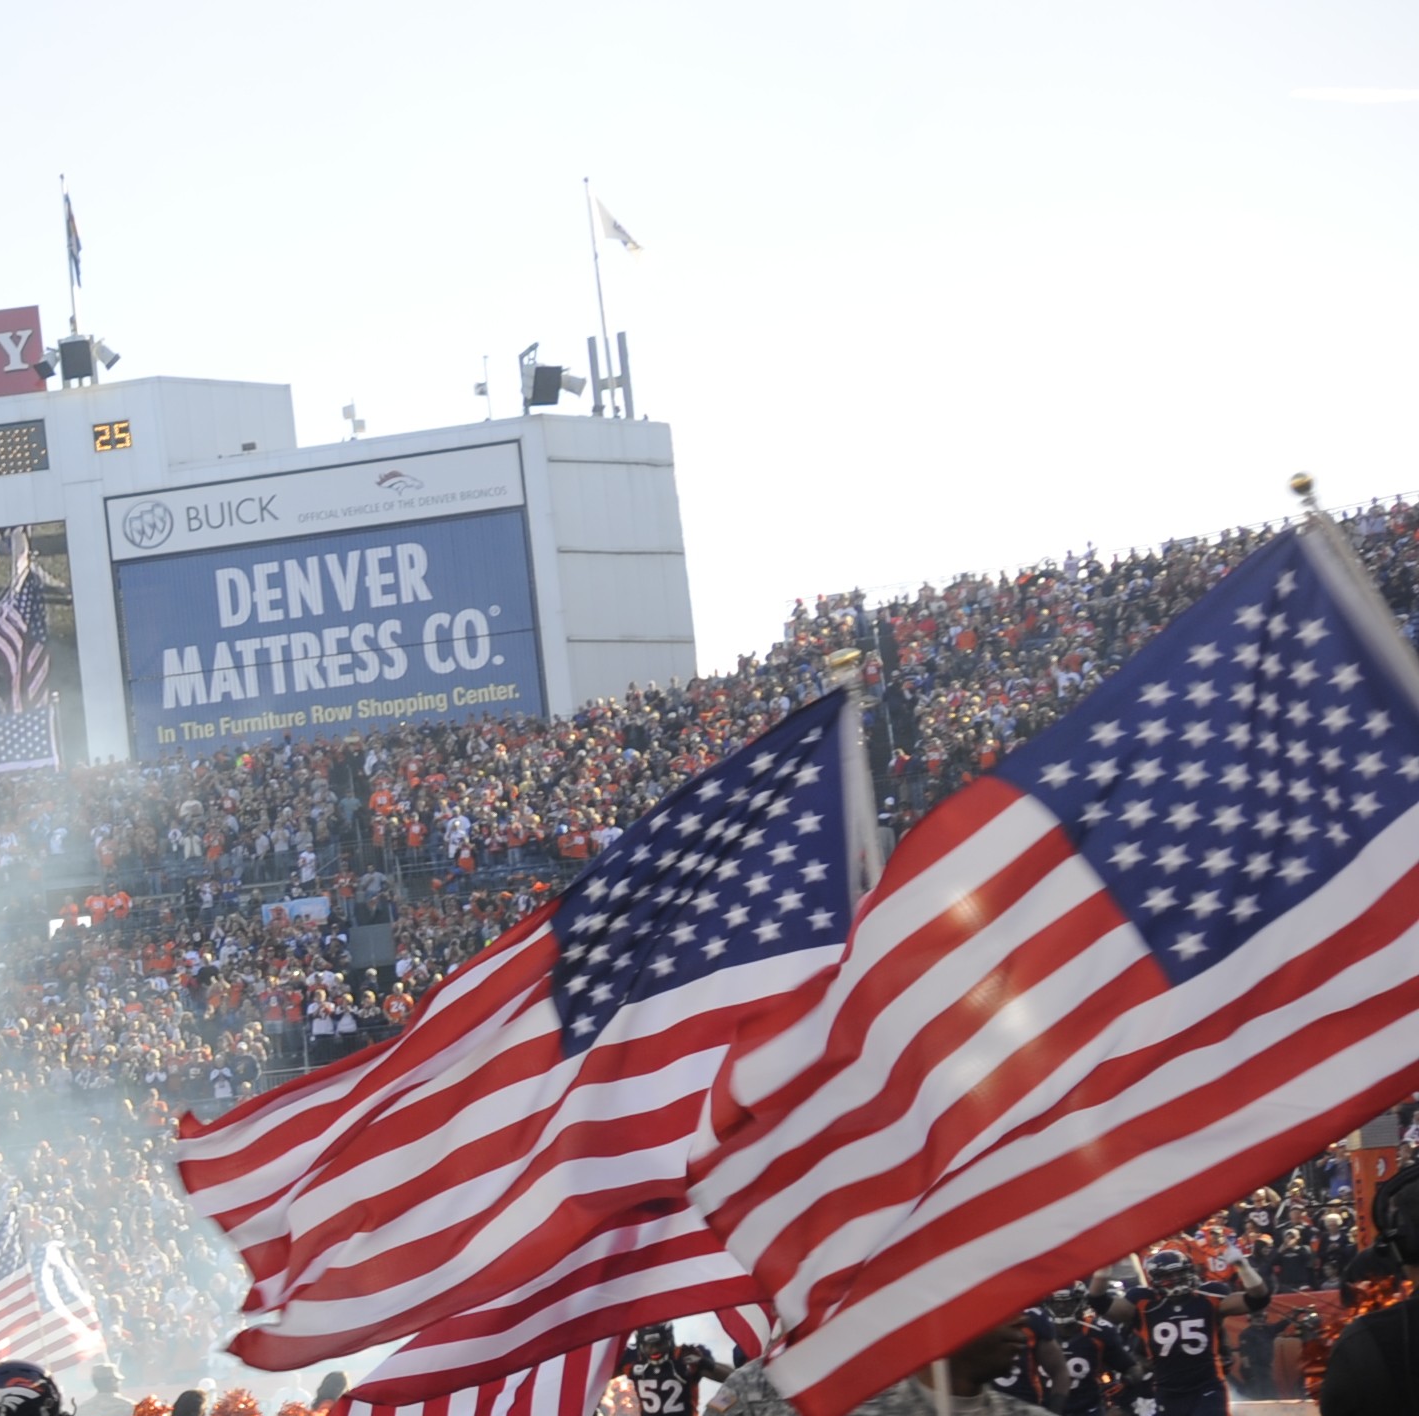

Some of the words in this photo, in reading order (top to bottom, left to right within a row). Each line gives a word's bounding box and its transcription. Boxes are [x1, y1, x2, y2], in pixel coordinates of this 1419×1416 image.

[95, 421, 132, 451] 25
[185, 494, 279, 533] BUICK
[297, 509, 341, 524] OFFICIAL
[340, 504, 382, 517] VEHICLE
[383, 500, 396, 512] OF
[397, 498, 416, 510] THE
[418, 492, 459, 507] DENVER
[459, 485, 508, 501] BRONCOS
[214, 542, 433, 629] DENVER
[161, 618, 410, 710] MATTRESS
[157, 725, 176, 744] In
[179, 719, 216, 742] The
[219, 708, 307, 737] Furniture
[310, 702, 354, 725] Row
[357, 689, 449, 721] Shopping
[450, 683, 521, 708] Center.
[390, 1001, 406, 1012] 24
[1152, 1318, 1209, 1358] 95
[637, 1378, 686, 1414] 52
